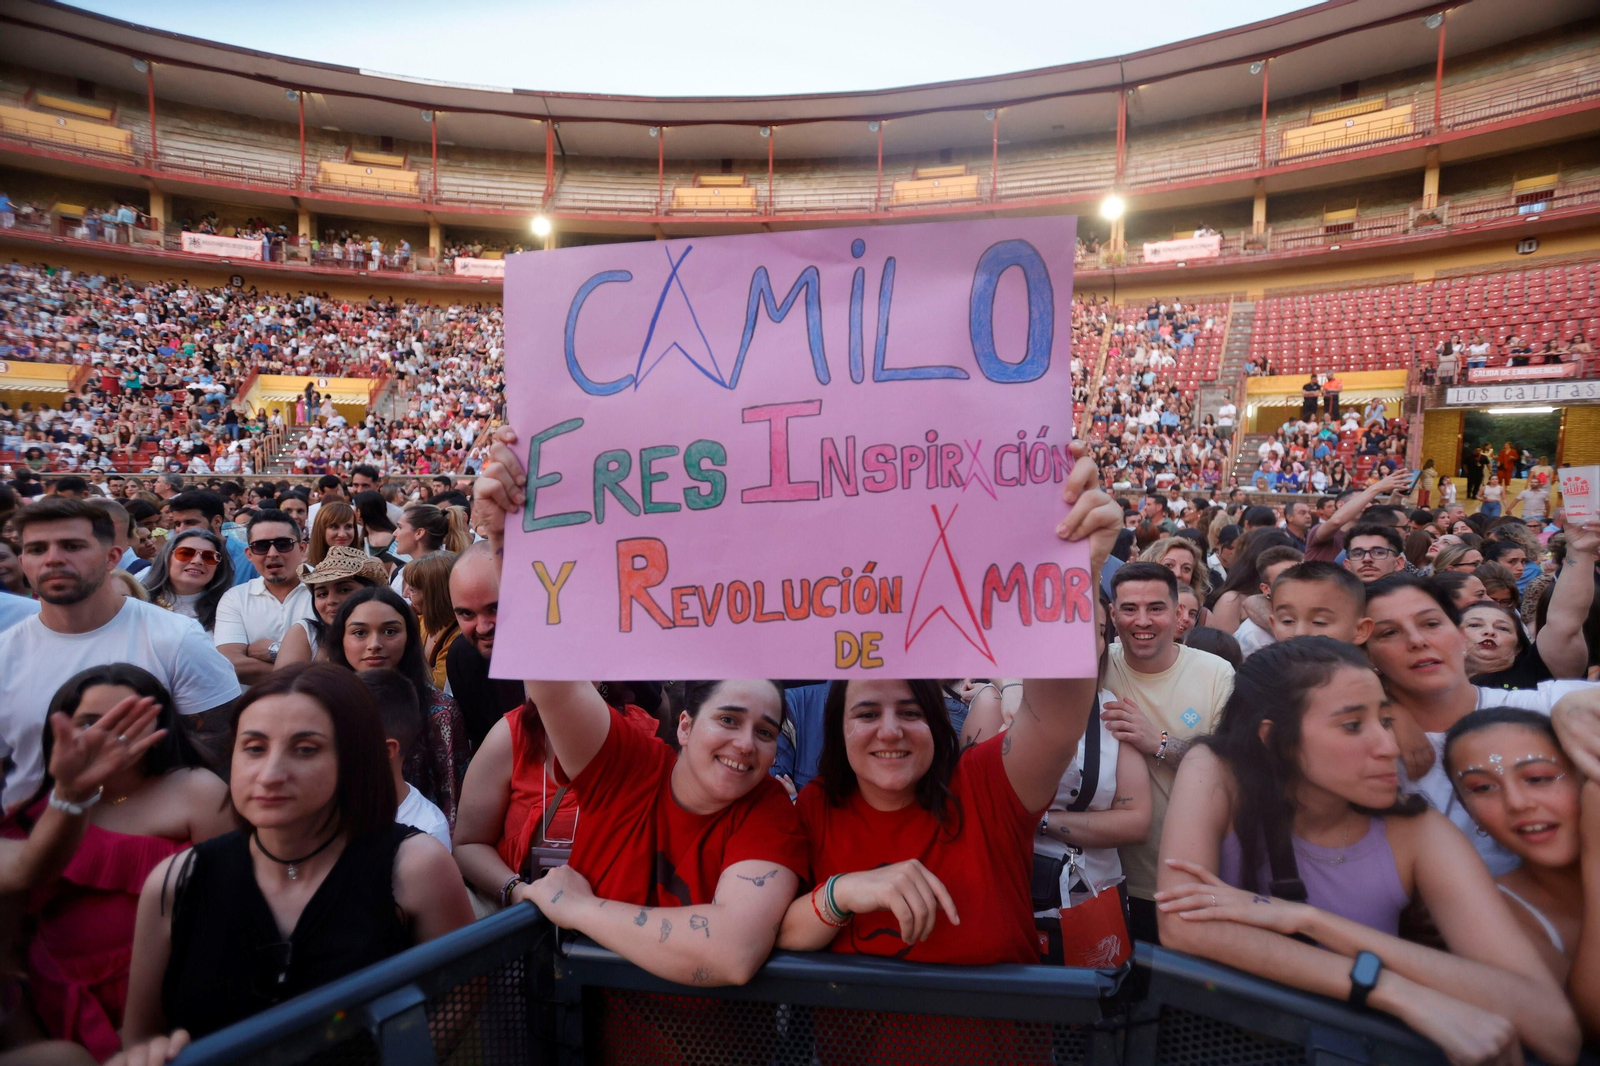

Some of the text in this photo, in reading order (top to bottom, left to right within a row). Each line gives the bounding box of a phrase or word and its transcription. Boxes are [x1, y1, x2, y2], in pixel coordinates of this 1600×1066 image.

[1473, 368, 1499, 378] SALIDA
[1500, 368, 1510, 376] DE
[1456, 387, 1489, 402] LOS
[522, 417, 727, 532] ERES
[532, 561, 576, 625] Y
[905, 503, 1093, 666] AMOR
[835, 631, 884, 668] DE
